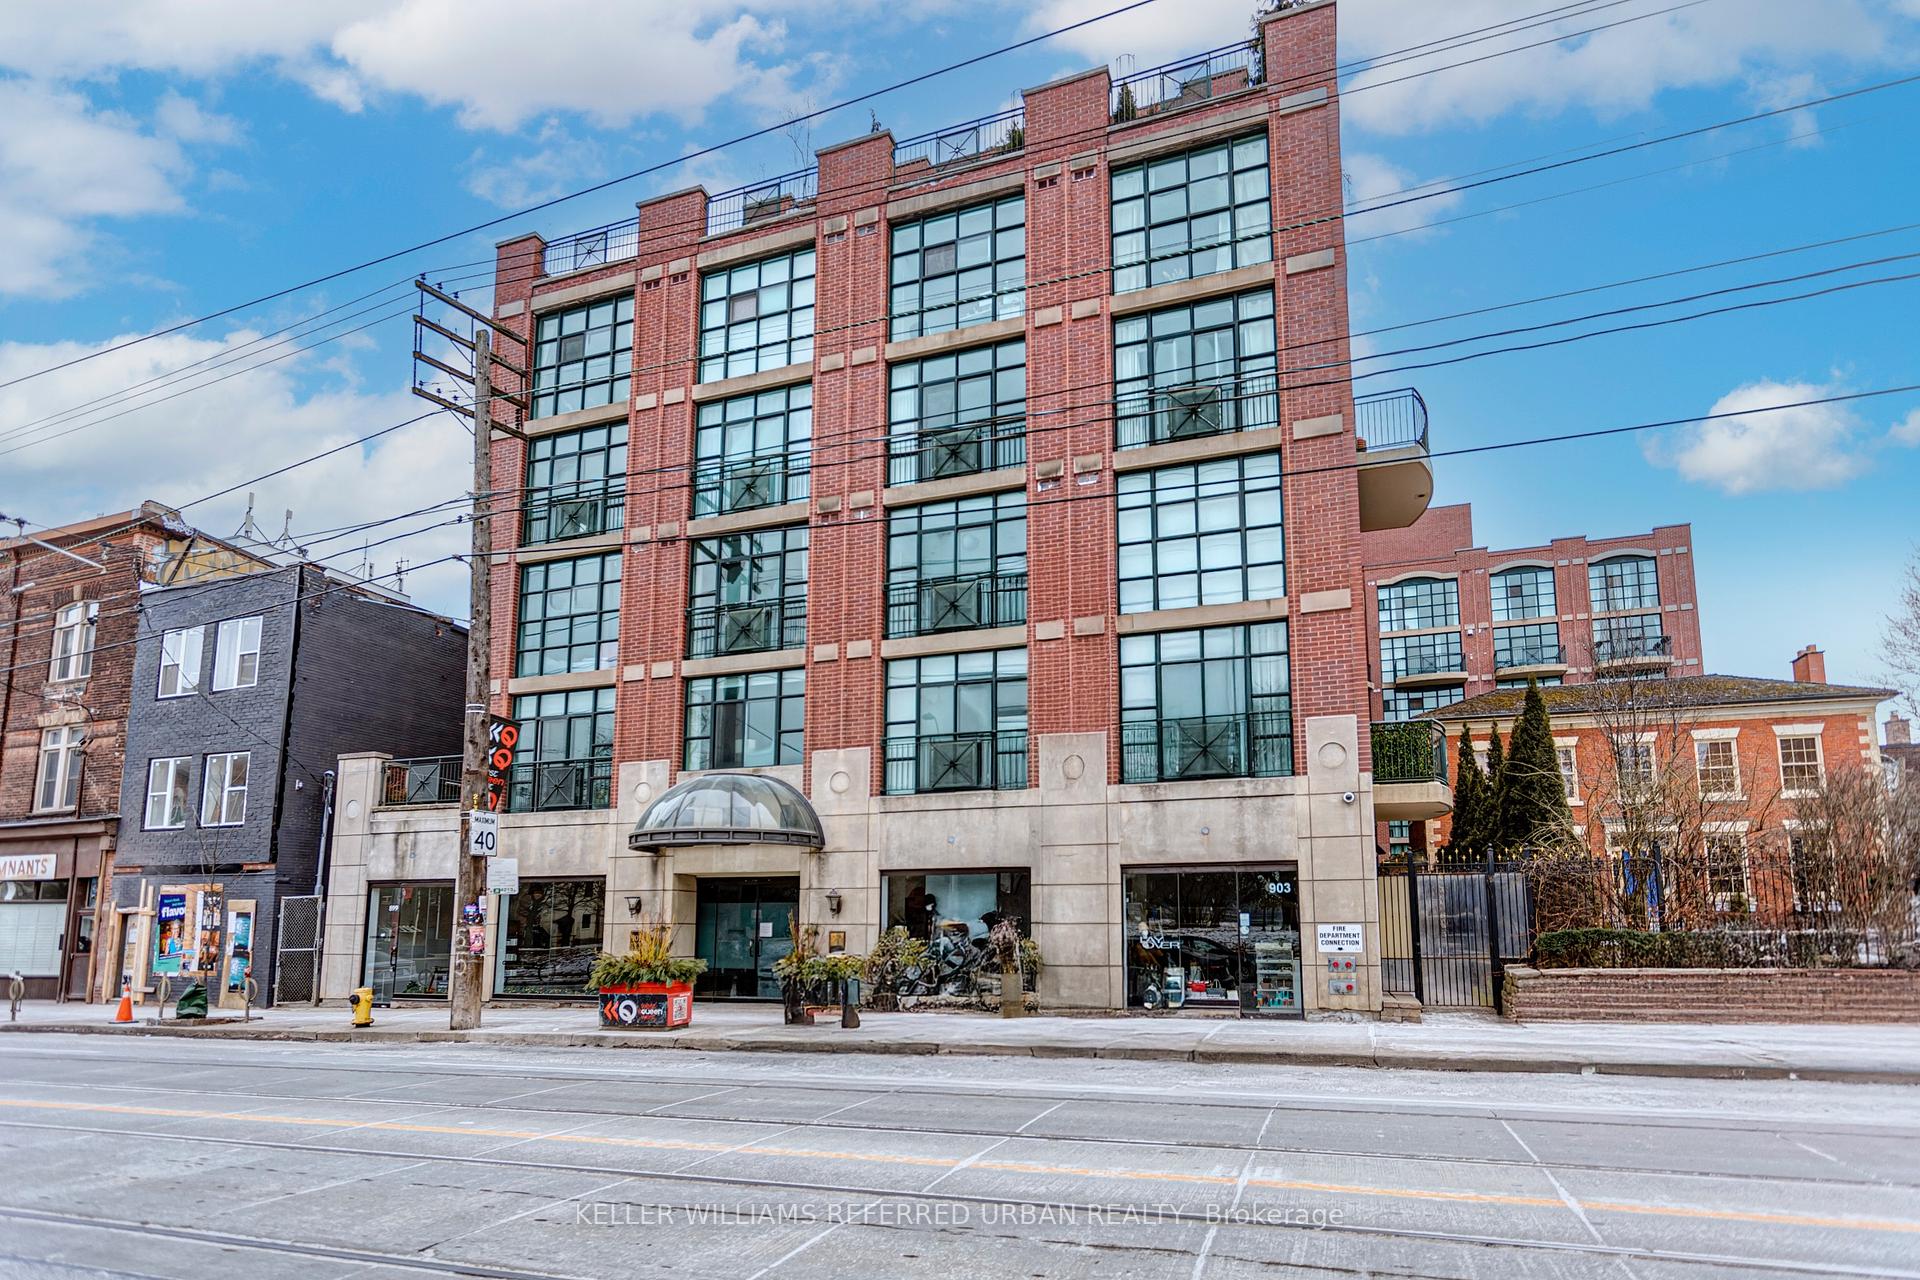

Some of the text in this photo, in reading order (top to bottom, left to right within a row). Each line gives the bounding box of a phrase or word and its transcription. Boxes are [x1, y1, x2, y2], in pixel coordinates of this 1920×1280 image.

[474, 816, 496, 825] MAXIMUM
[474, 830, 495, 850] 40
[1268, 882, 1291, 894] 903
